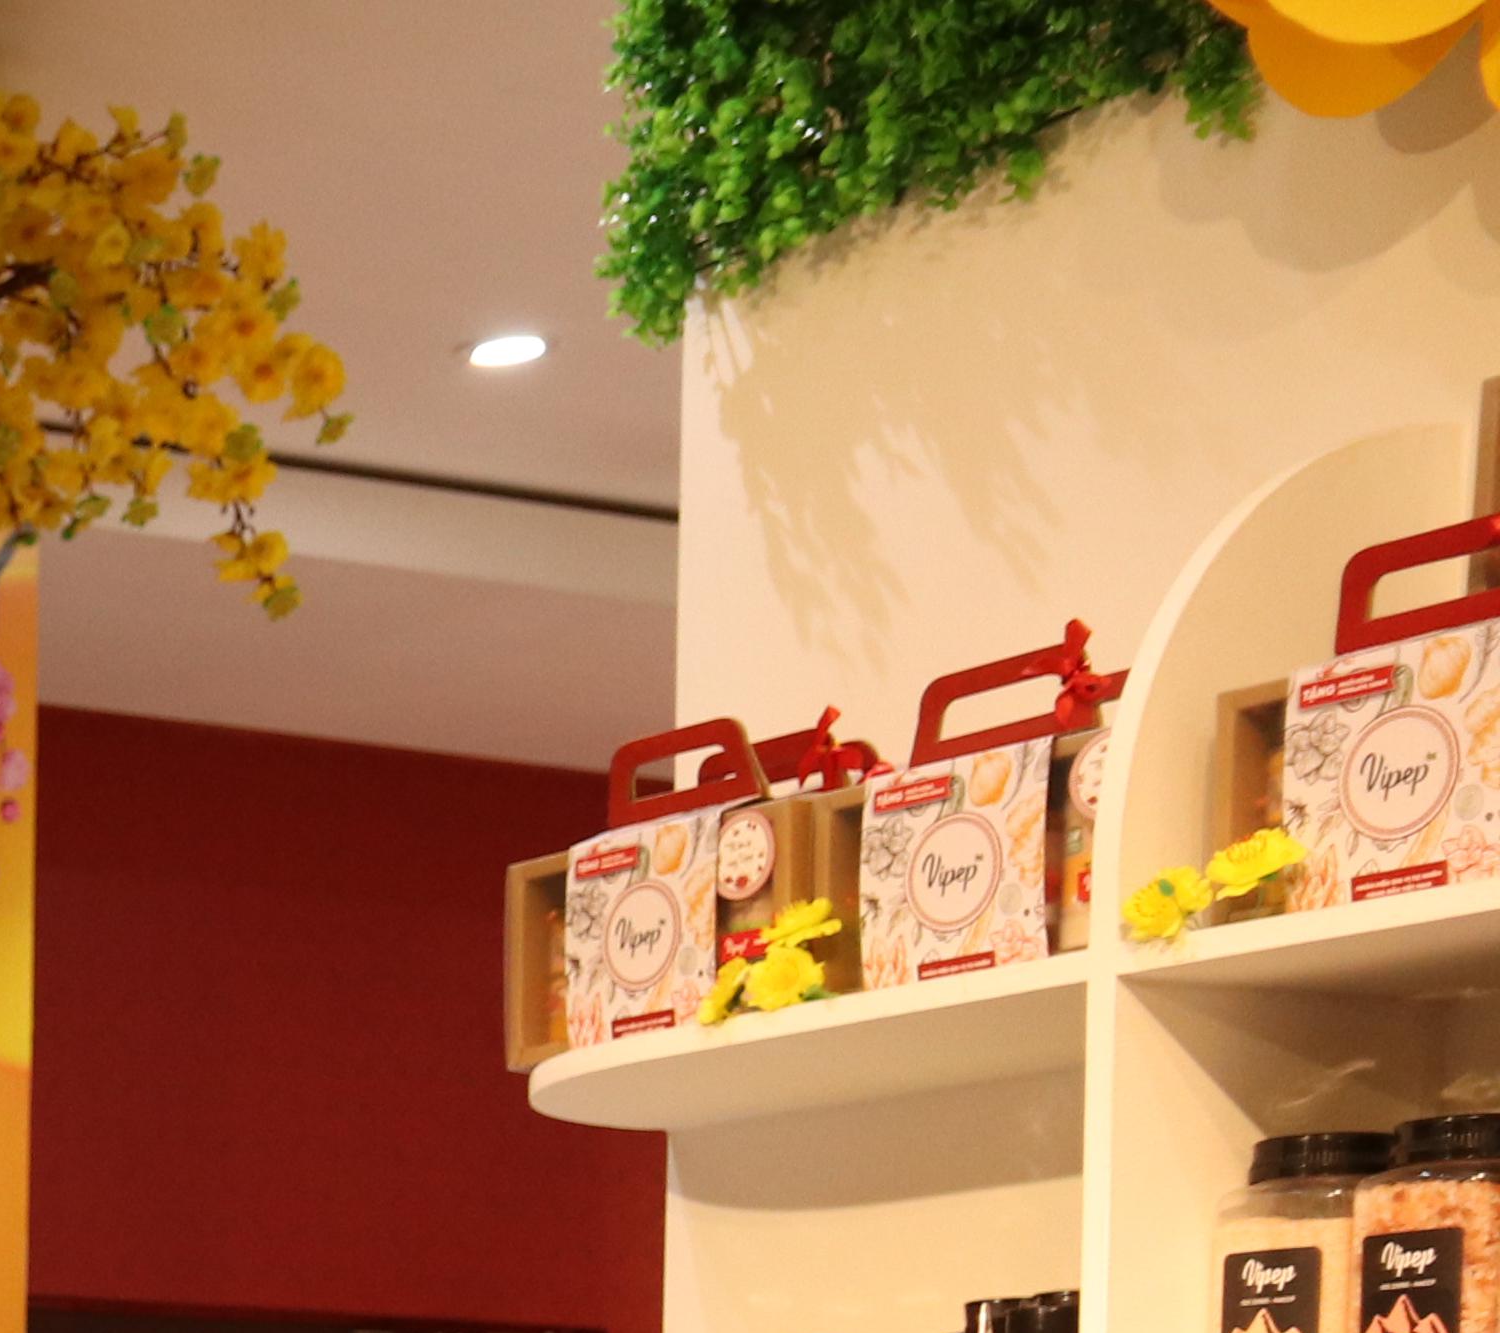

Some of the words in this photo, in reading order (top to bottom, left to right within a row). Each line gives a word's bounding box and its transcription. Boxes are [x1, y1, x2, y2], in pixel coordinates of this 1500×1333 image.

[1359, 752, 1431, 802] Vipep
[922, 853, 978, 897] Vipep
[615, 918, 662, 959] Vipep
[1241, 1259, 1296, 1294] Vipep
[1380, 1241, 1437, 1277] Vipep
